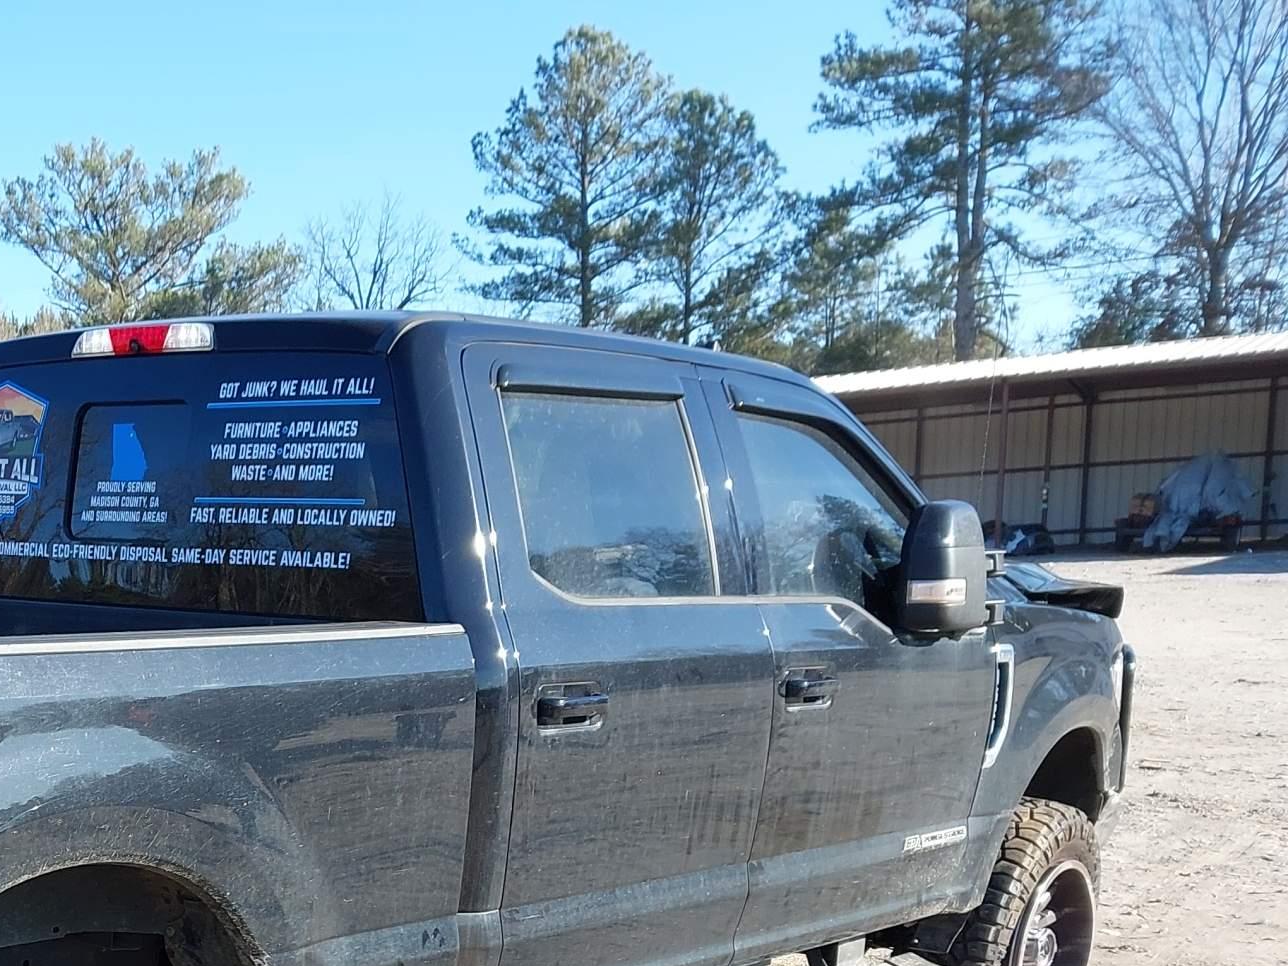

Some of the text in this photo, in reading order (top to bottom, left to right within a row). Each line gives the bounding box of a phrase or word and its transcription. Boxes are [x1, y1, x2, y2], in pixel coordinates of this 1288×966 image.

[219, 377, 375, 398] GOT JUNK? WE HAUL IT ALL!
[224, 420, 359, 439] FURNITURE APPLIANCES
[210, 442, 365, 460] YARD DEBRIS CONSTRUCTION
[11, 458, 39, 483] ALL
[231, 464, 335, 481] WASTE AND MORE!
[14, 482, 26, 492] LLC
[97, 481, 156, 493] PROUDLY SERVING
[91, 496, 160, 509] MADISON COUNTY, GA
[81, 510, 168, 523] AND SURROUNDING AREAS!
[190, 507, 396, 527] FAST, RELIABLE AND LOCALLY OWNED!
[52, 543, 117, 560] ECO-FRIENDLY
[120, 546, 168, 562] DISPOSAL
[171, 548, 226, 565] SAME-DAY
[229, 549, 277, 566] SERVICE
[280, 551, 351, 569] AVAILABLE!
